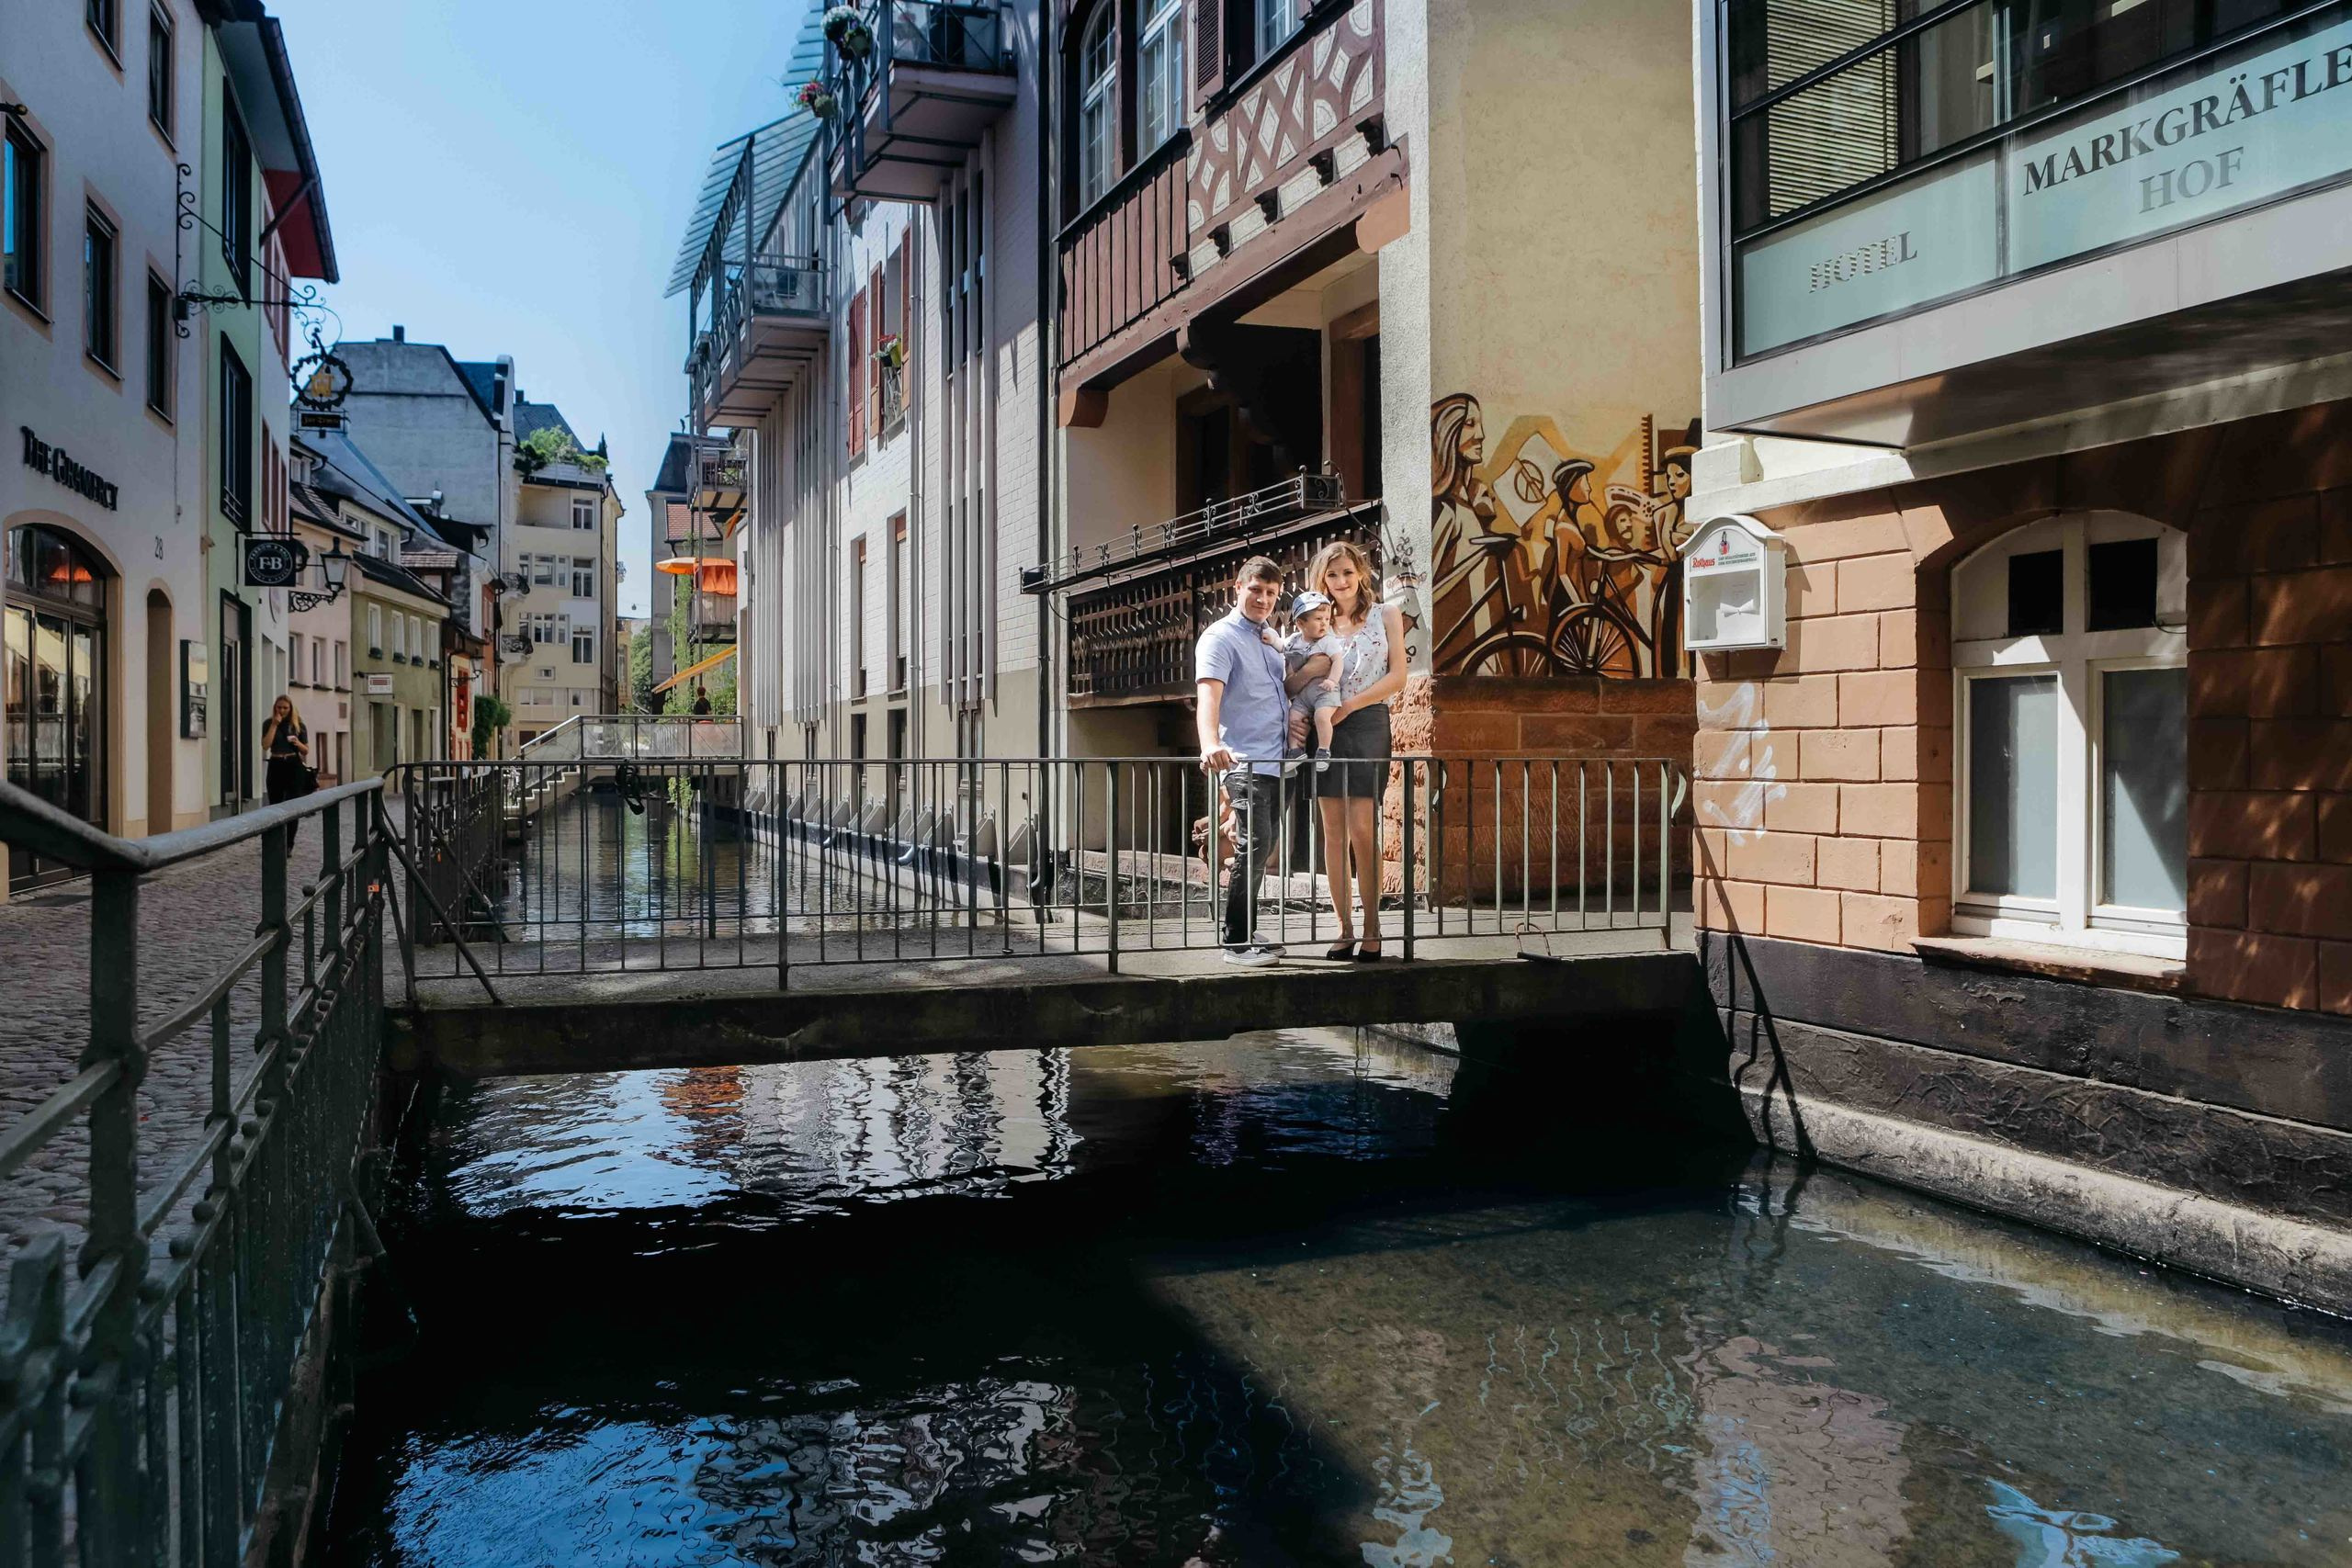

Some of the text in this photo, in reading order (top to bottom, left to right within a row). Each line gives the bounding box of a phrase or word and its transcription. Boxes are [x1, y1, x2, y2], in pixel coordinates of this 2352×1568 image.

[2139, 146, 2245, 213] HOF
[1808, 231, 1917, 294] HOTEL
[20, 425, 52, 476] THE
[154, 536, 164, 560] 28
[1692, 557, 1715, 569] Rothaus
